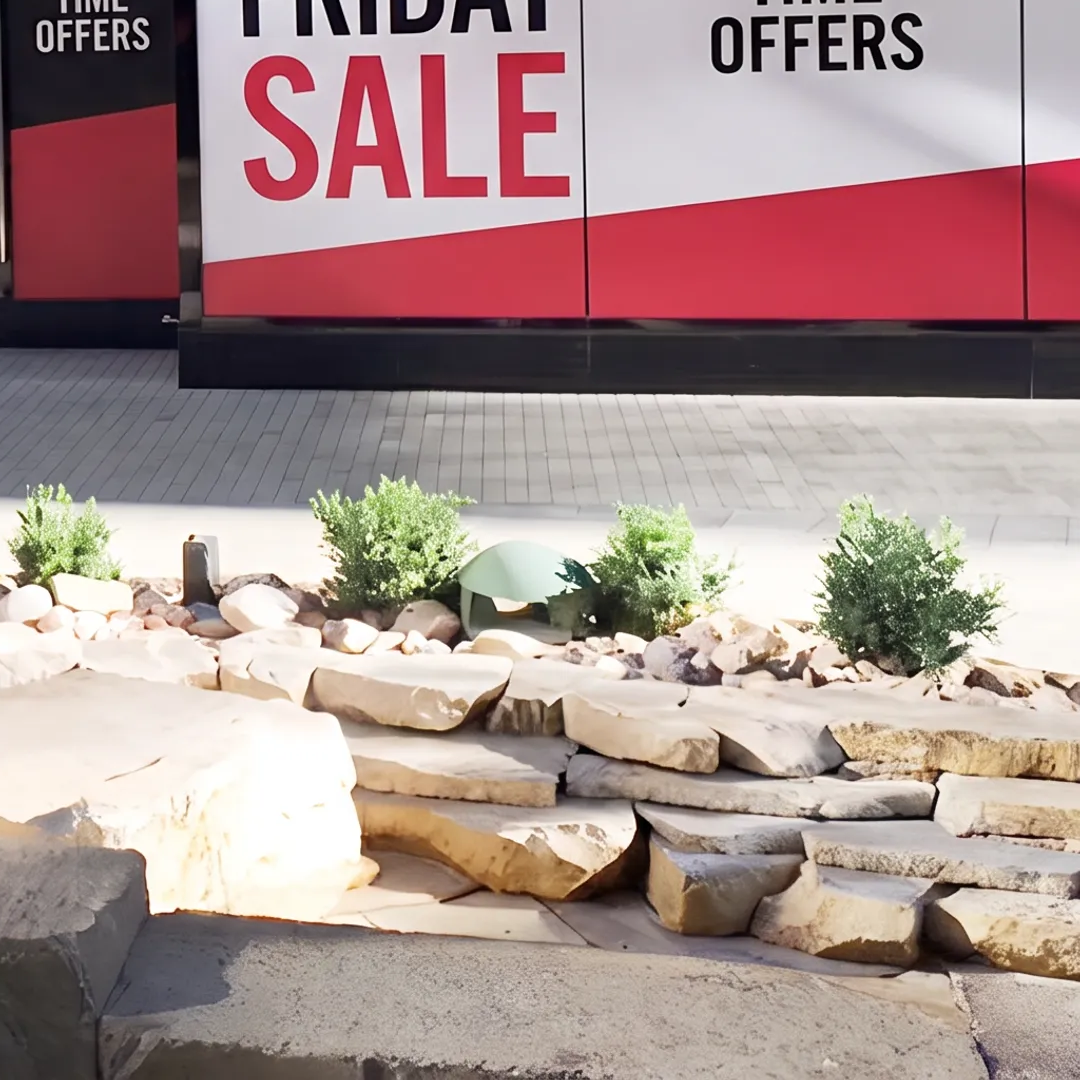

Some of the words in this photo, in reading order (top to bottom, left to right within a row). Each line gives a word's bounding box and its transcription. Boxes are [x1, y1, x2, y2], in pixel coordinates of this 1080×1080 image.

[36, 17, 150, 53] OFFERS
[711, 13, 924, 74] OFFERS
[243, 52, 570, 201] SALE
